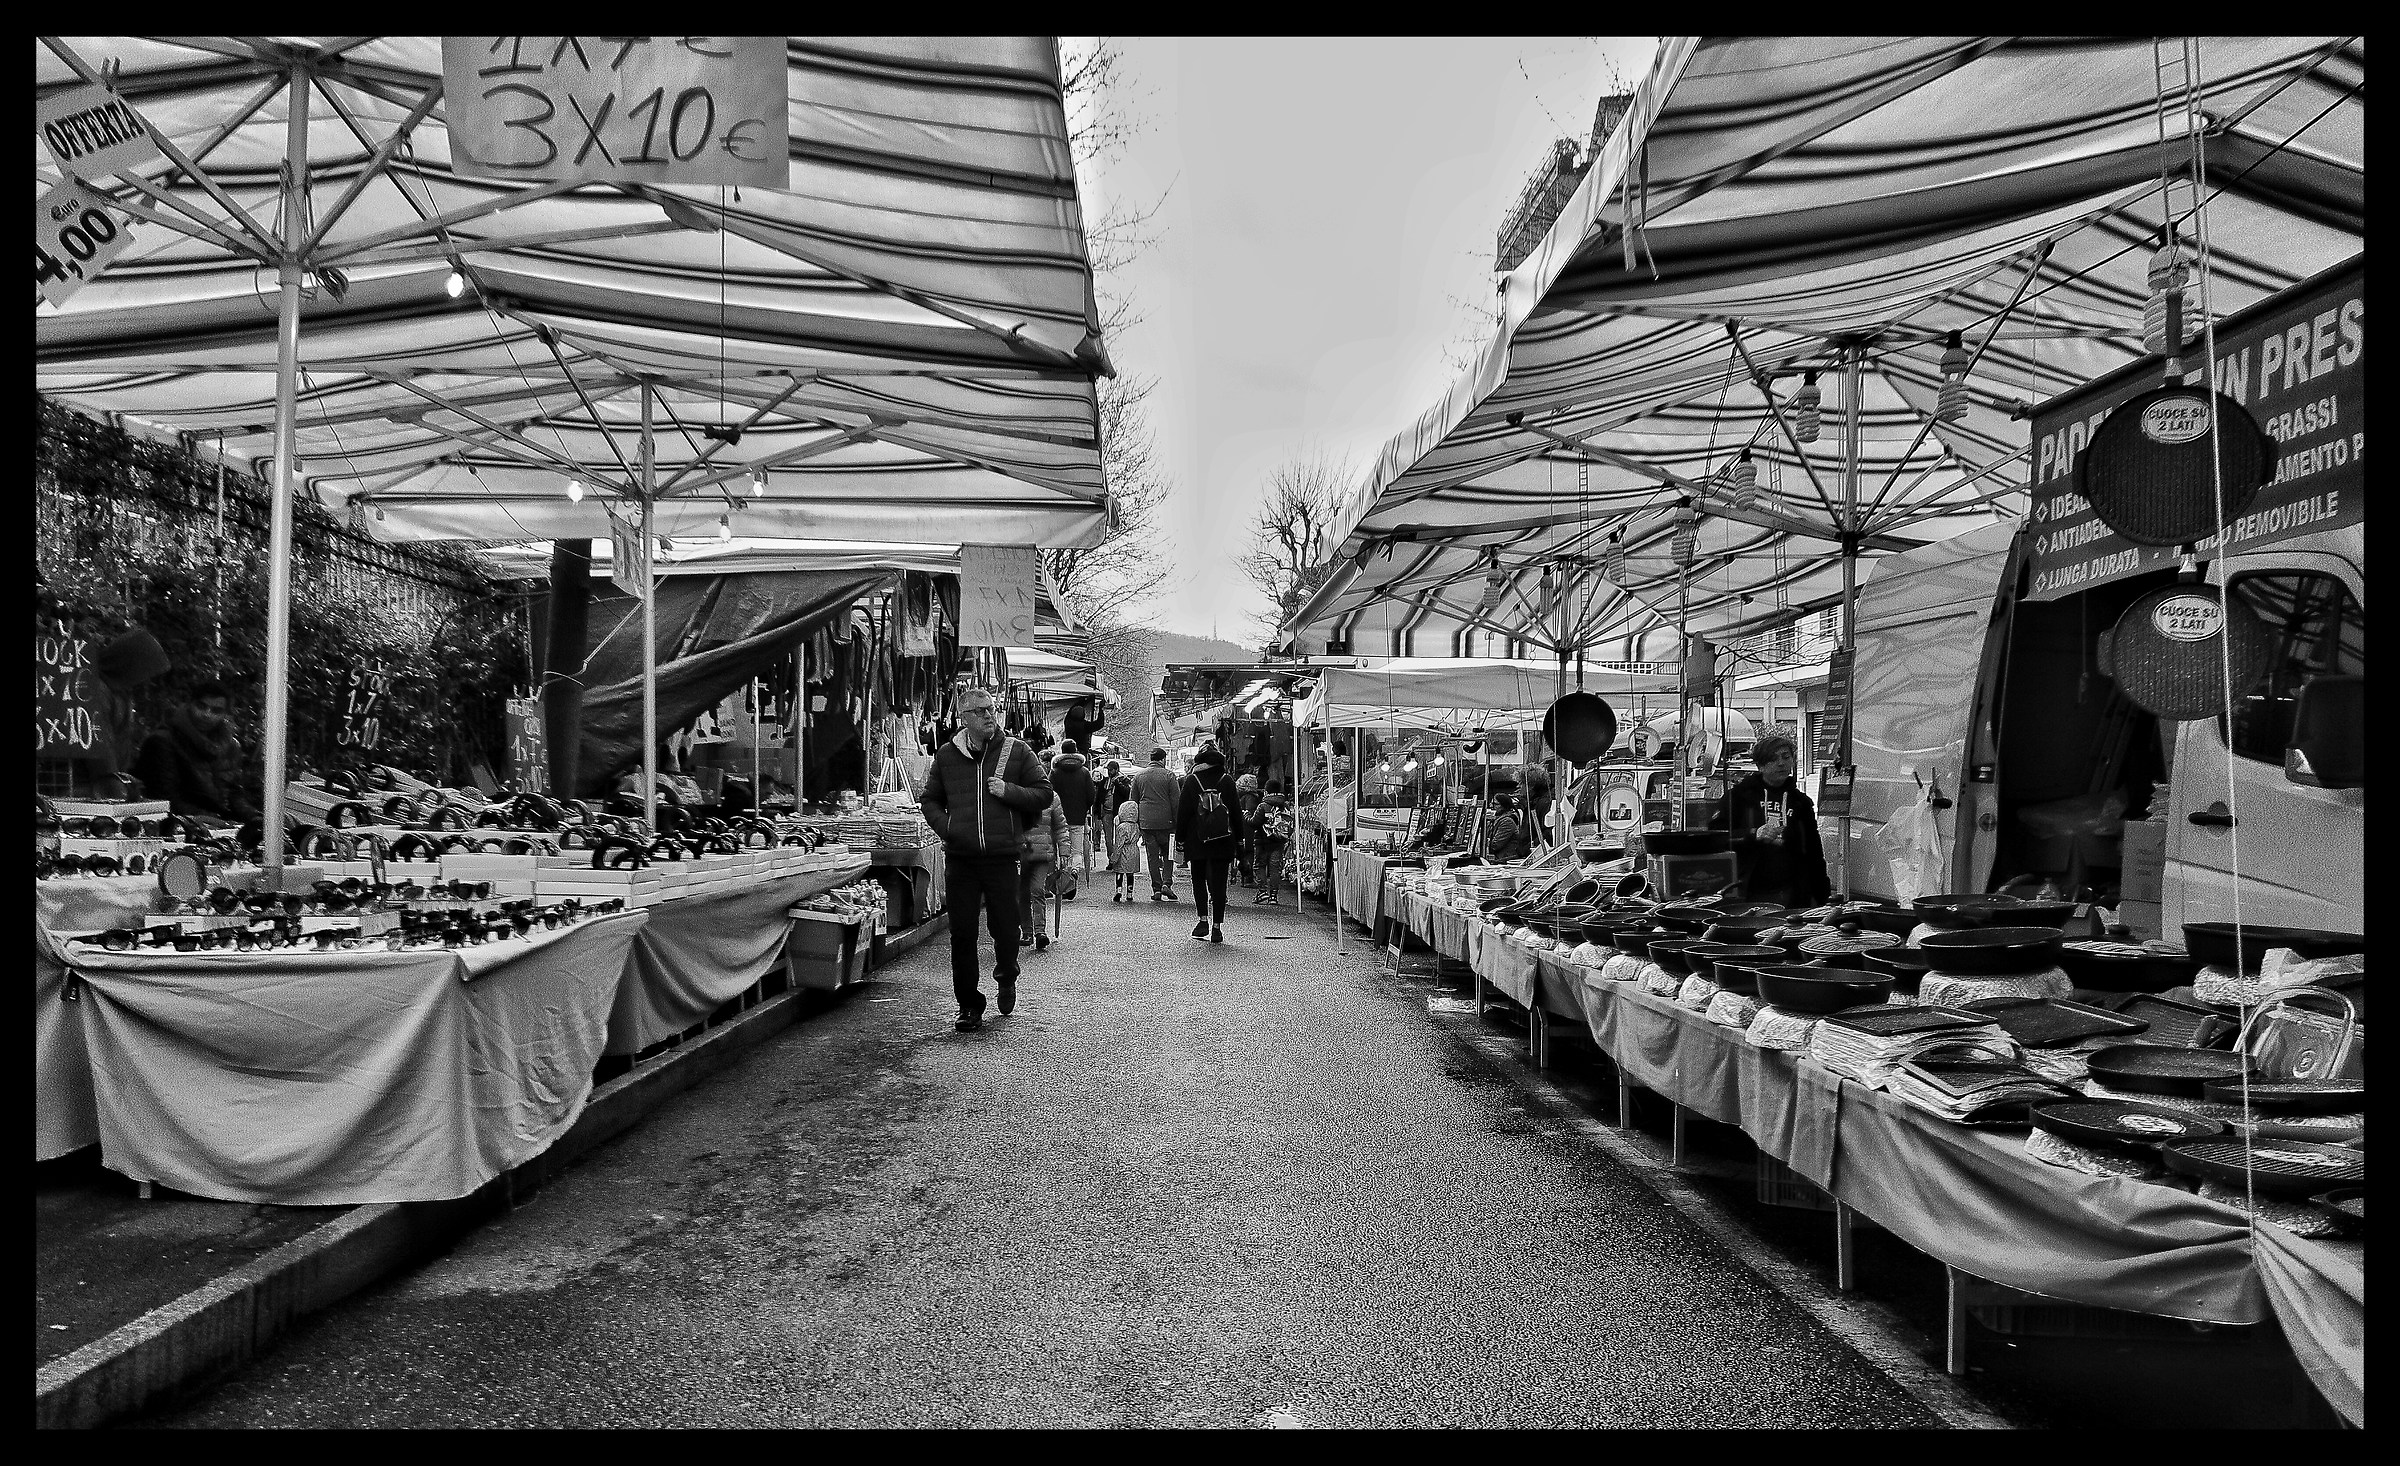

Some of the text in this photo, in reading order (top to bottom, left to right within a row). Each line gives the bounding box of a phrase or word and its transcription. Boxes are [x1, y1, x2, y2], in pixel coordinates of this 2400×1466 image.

[43, 97, 145, 161] OFFERTA
[2259, 298, 2365, 400] PRES
[2149, 406, 2208, 419] CUOCE SU
[2158, 420, 2195, 431] 2 LATI
[2265, 395, 2338, 444] GRASSI
[2262, 438, 2348, 488] AMENTO
[2047, 561, 2088, 590] LUNGA
[2089, 547, 2140, 580] DURATA
[2234, 490, 2339, 543] REMOVIBILE
[2160, 605, 2219, 618] CUOCE SU
[2169, 618, 2206, 630] 2 LATI
